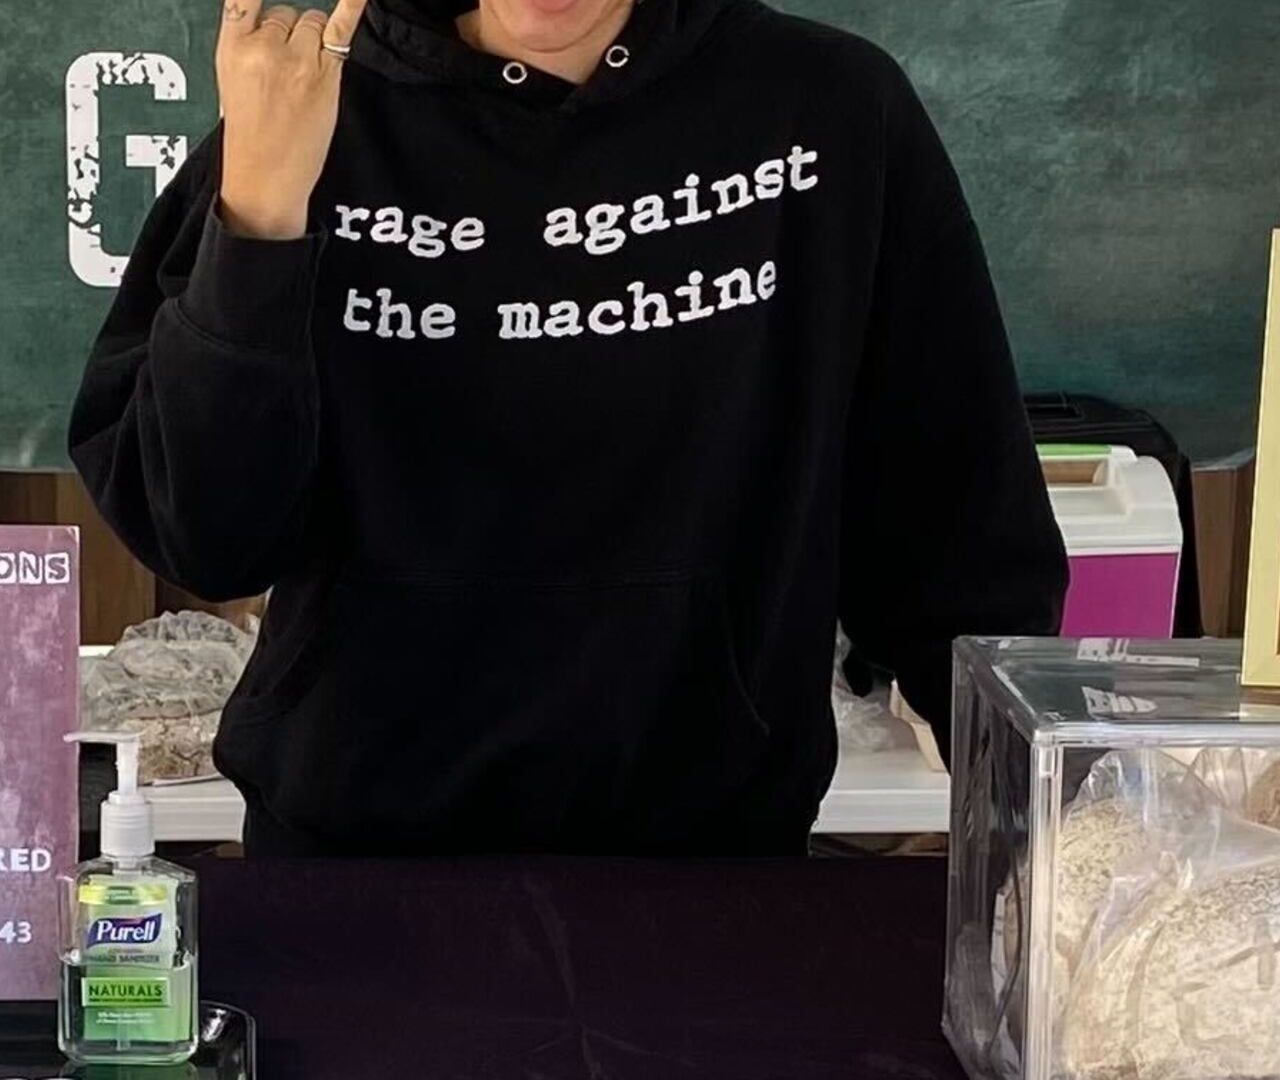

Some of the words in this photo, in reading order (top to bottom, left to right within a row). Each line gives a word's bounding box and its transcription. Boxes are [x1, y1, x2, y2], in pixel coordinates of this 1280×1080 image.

[335, 204, 485, 258] rage
[543, 145, 818, 255] against
[343, 288, 456, 339] the
[497, 260, 776, 339] machine
[97, 919, 156, 941] Purell
[89, 984, 163, 997] NATURALS
